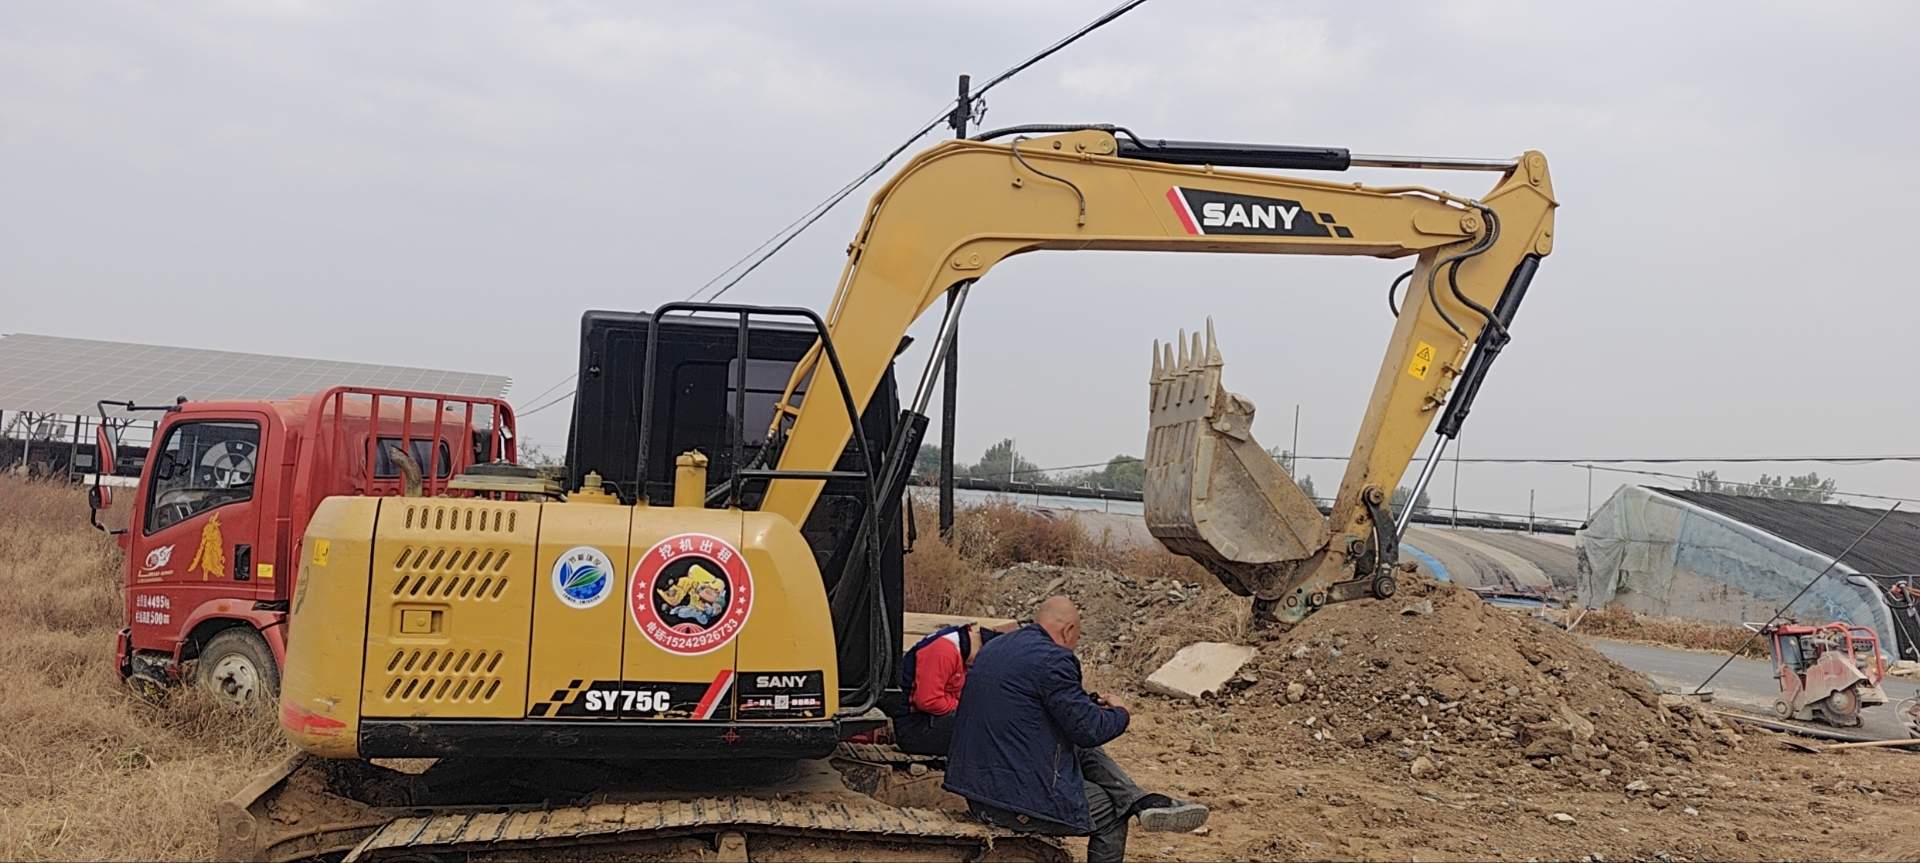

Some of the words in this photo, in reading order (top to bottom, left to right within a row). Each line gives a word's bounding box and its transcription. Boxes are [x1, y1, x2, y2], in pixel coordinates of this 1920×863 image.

[1202, 202, 1300, 230] SANY
[658, 537, 733, 564] 挖机出租
[756, 675, 807, 688] SANY
[585, 690, 670, 712] SY75C
